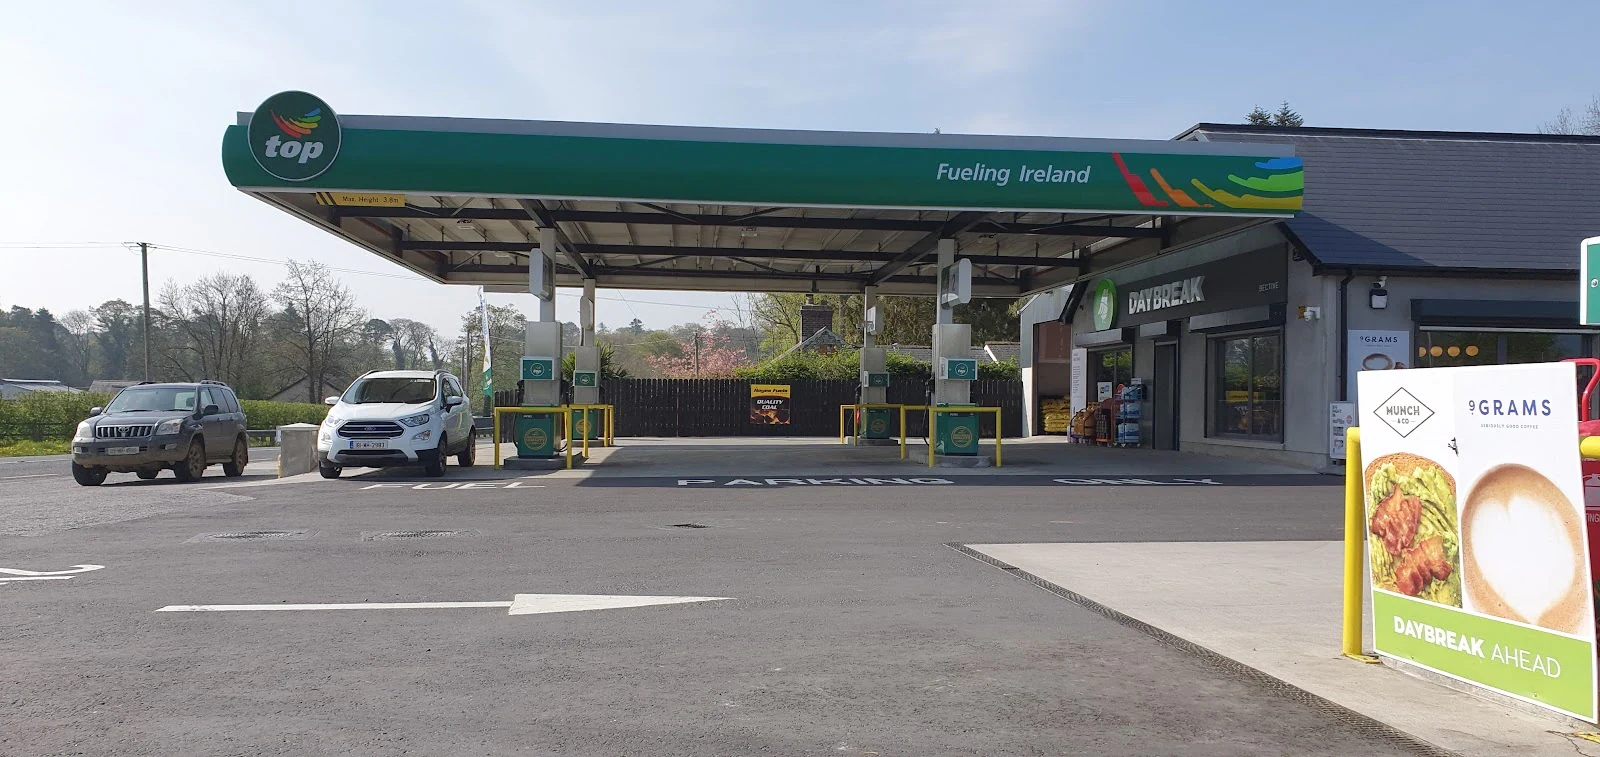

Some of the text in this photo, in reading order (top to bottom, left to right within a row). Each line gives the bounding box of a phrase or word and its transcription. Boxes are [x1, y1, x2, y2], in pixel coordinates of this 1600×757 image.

[265, 135, 324, 164] top
[936, 163, 1091, 186] Fueling Ireland
[358, 196, 379, 204] Height
[1128, 275, 1206, 315] DAYBREAK
[1386, 405, 1420, 416] MUNCH
[358, 481, 546, 490] FUEL
[677, 478, 955, 486] PARKING
[1393, 615, 1561, 678] DAYBREAK AHEAD
